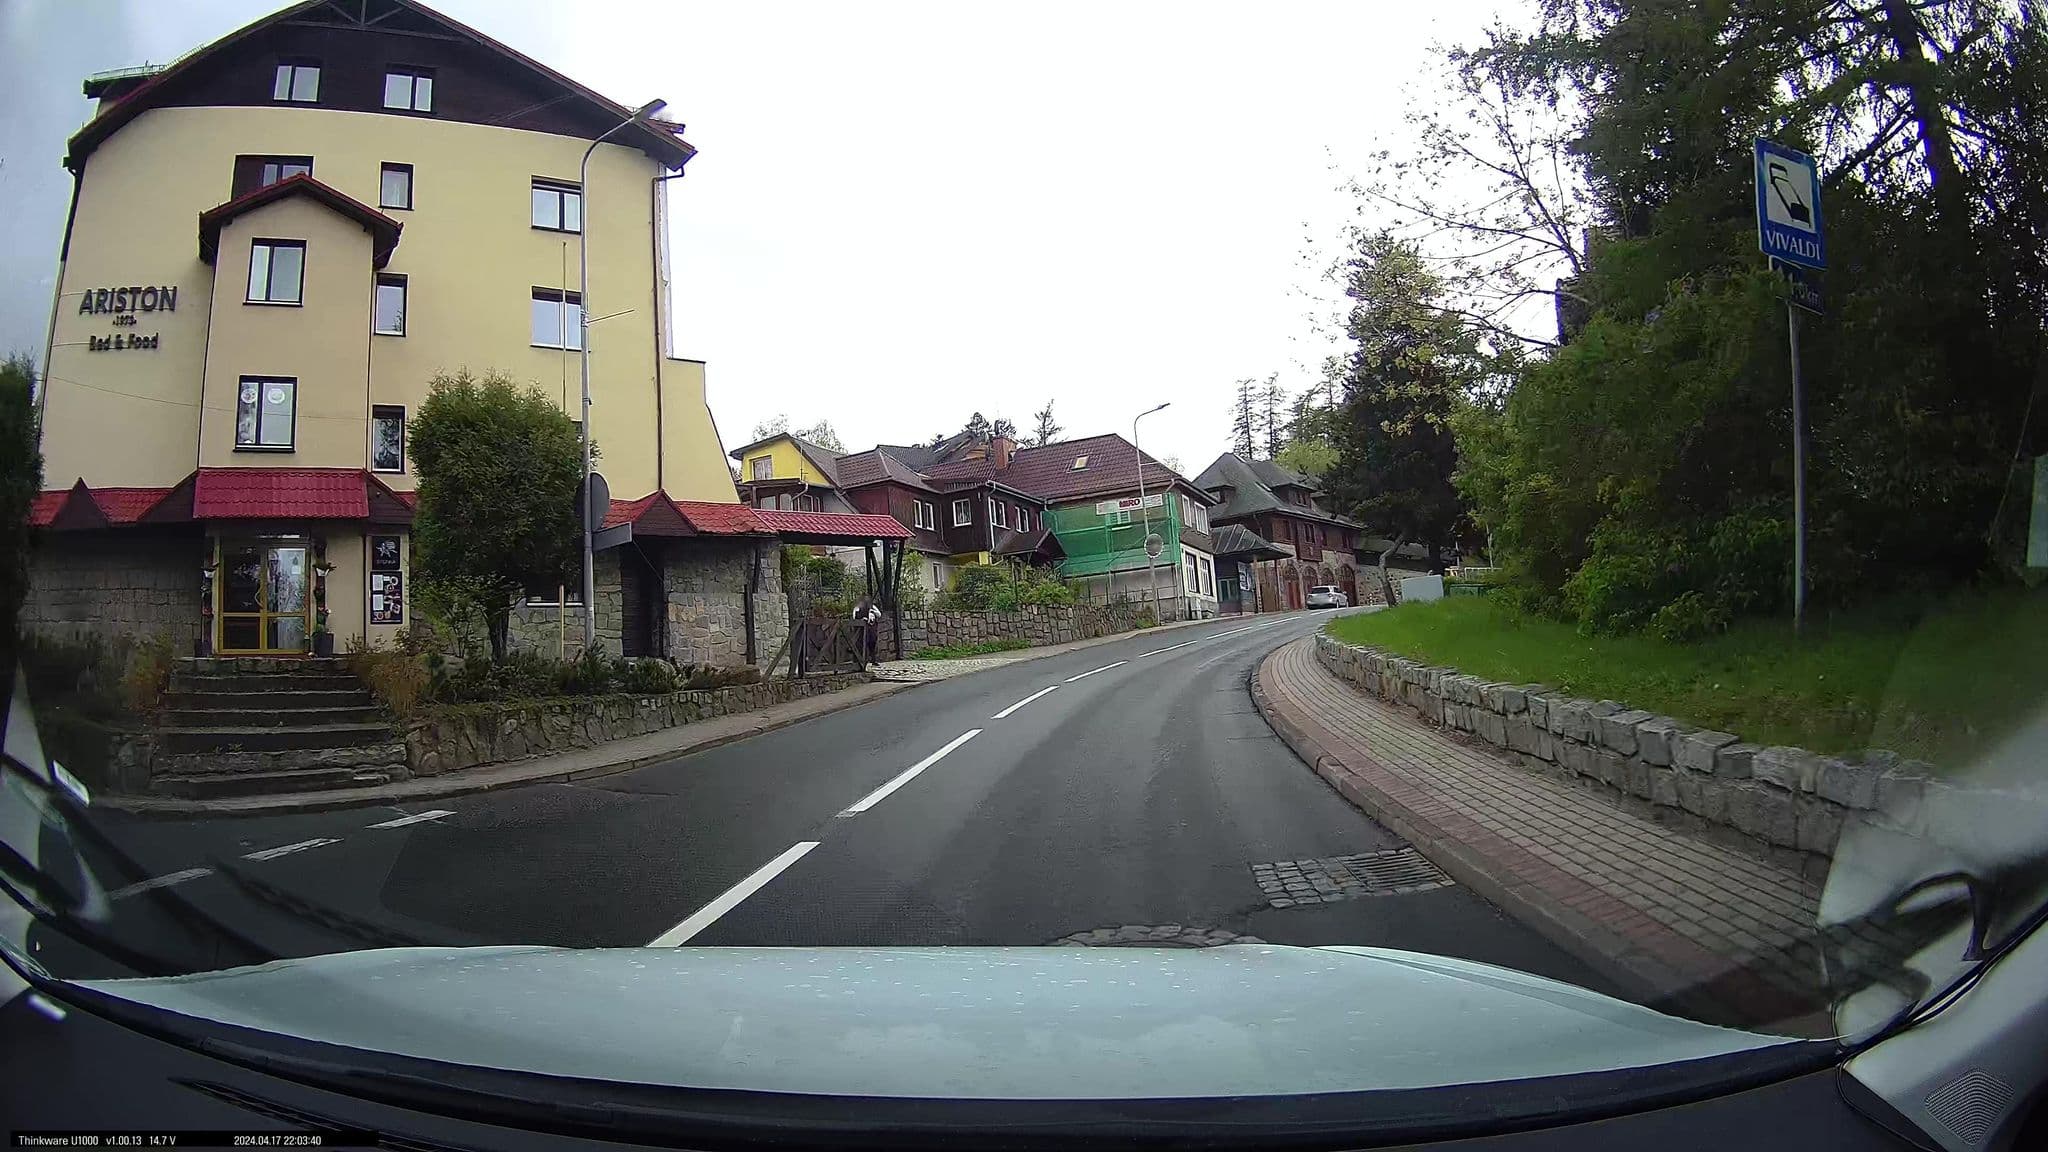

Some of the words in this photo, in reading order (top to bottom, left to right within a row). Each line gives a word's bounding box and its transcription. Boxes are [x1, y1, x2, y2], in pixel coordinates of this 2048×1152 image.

[1766, 229, 1821, 261] VIVALDI
[79, 286, 178, 315] ARISTON
[89, 335, 111, 351] Bed
[128, 332, 159, 349] Food
